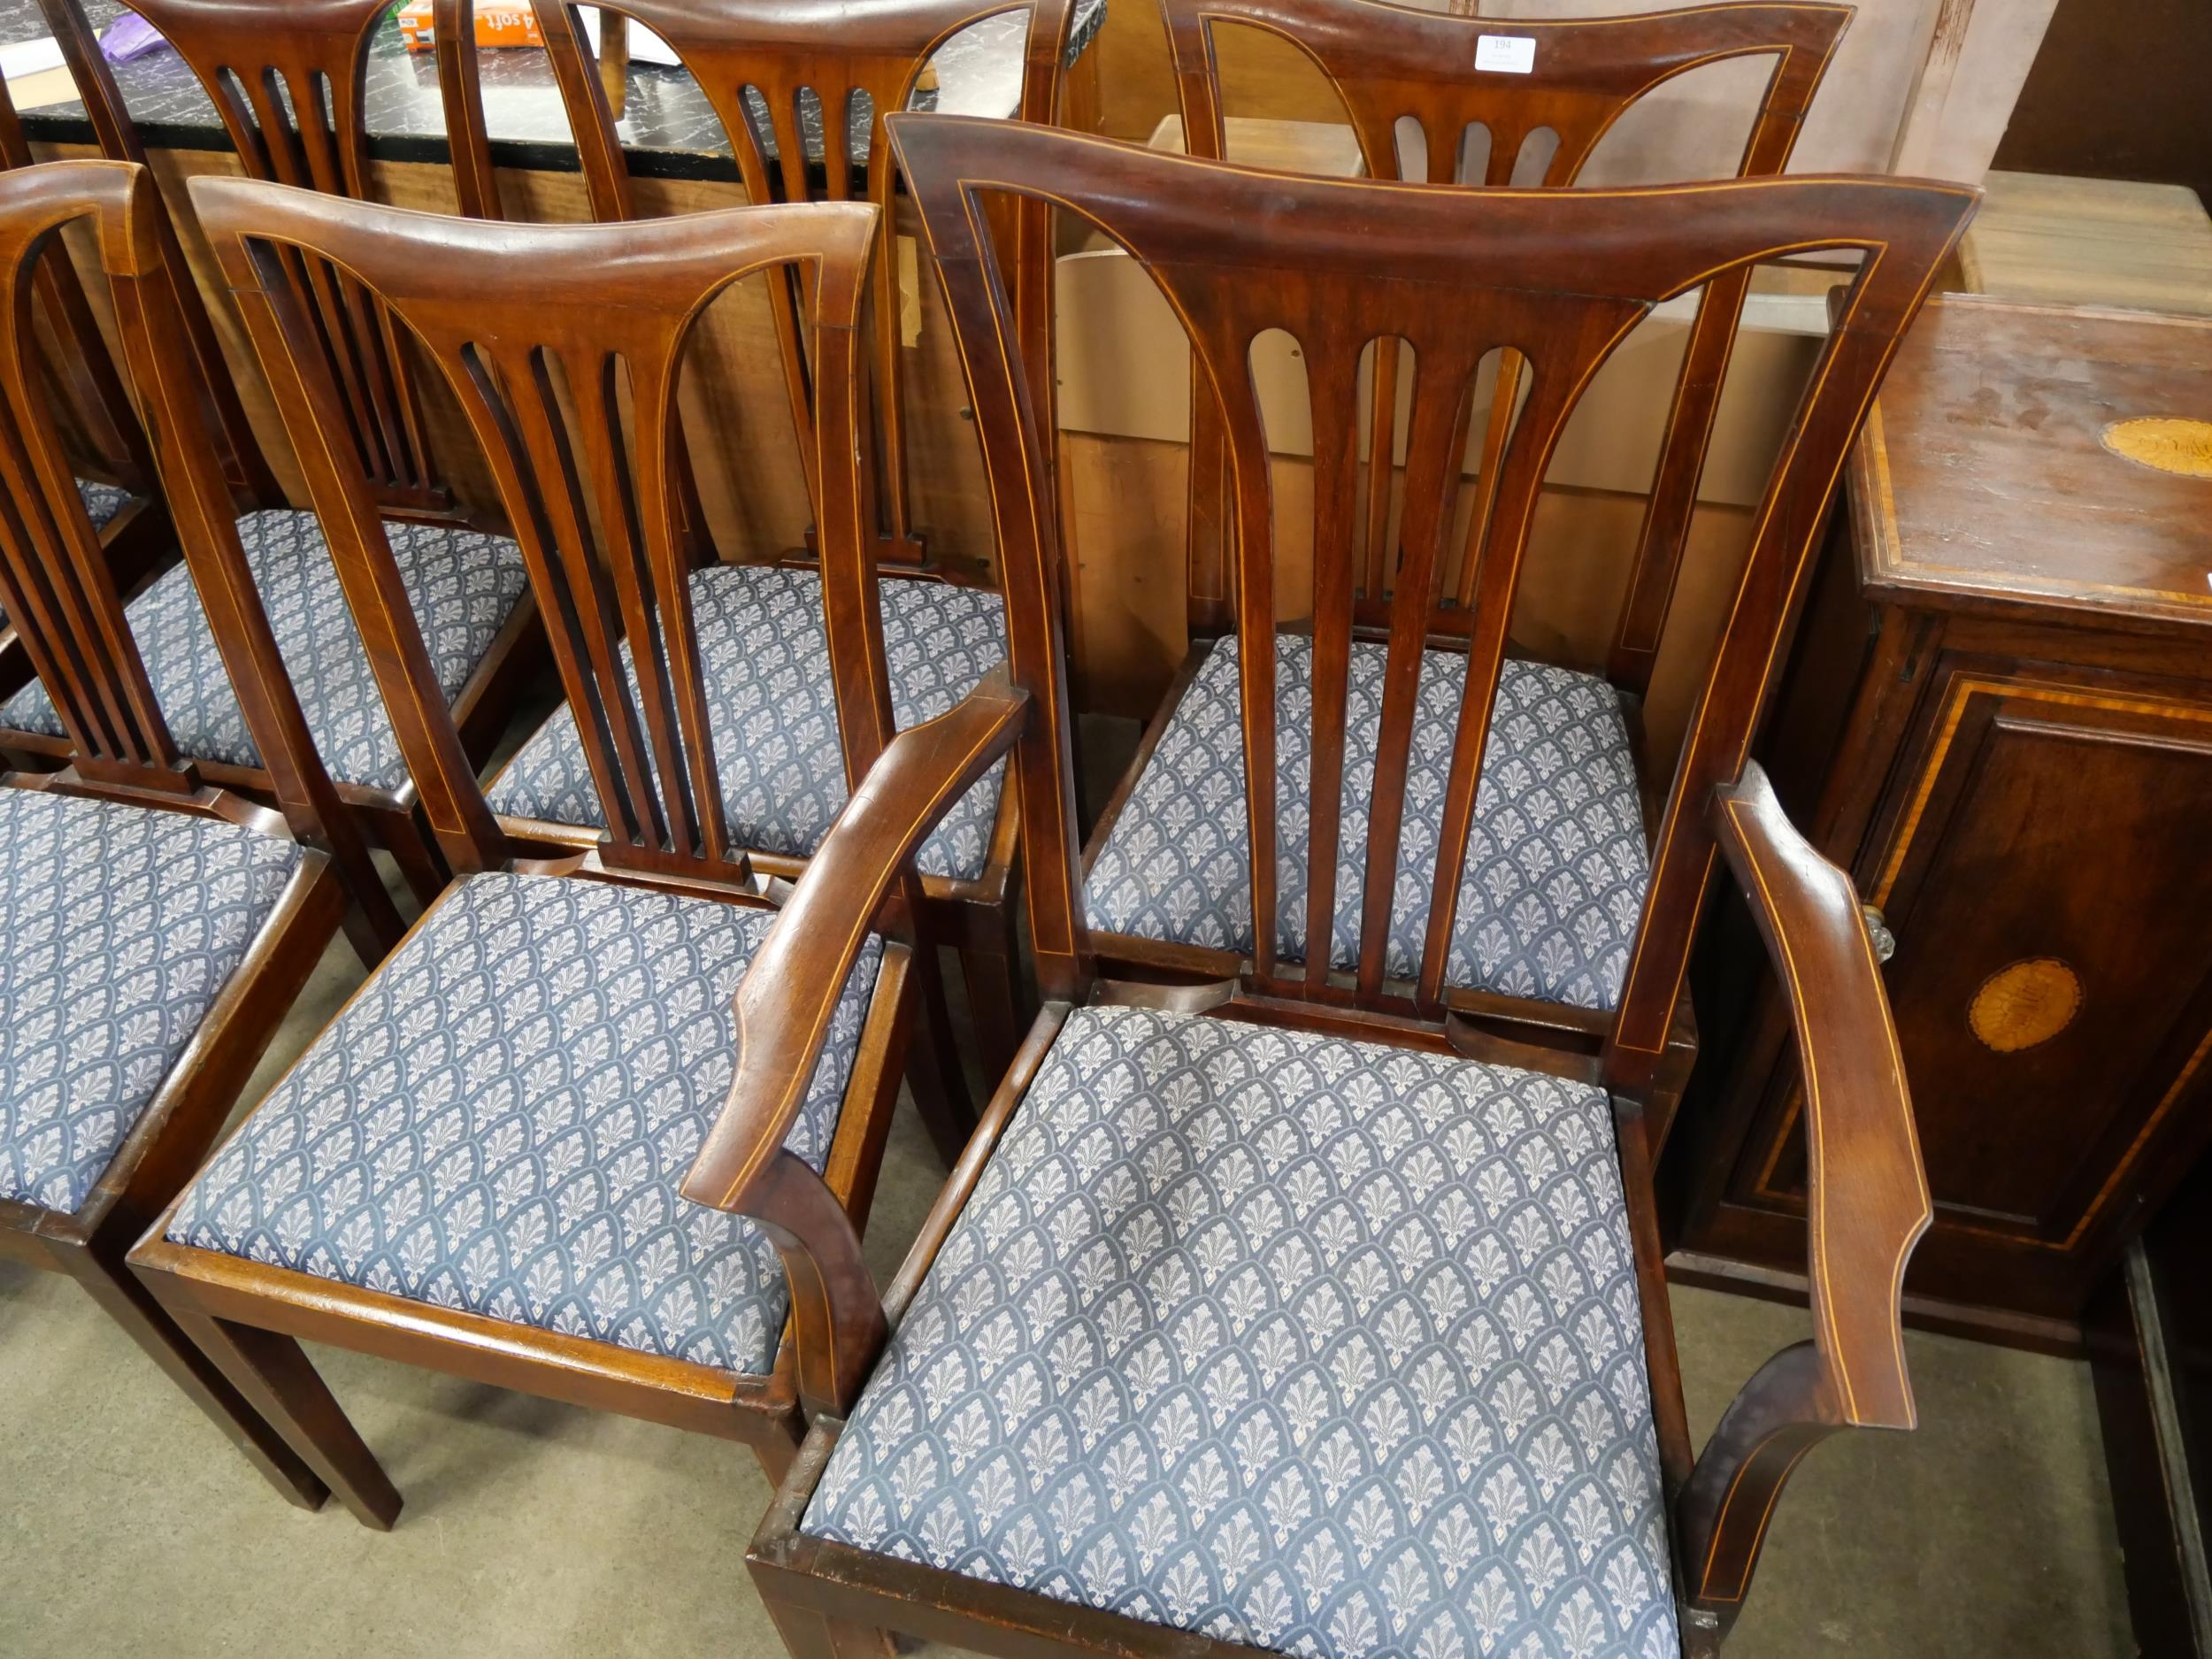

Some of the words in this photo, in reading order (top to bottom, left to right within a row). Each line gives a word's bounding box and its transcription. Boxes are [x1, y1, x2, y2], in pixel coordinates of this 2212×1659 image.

[488, 14, 520, 31] soft
[523, 13, 534, 30] 4
[1494, 40, 1511, 50] 194
